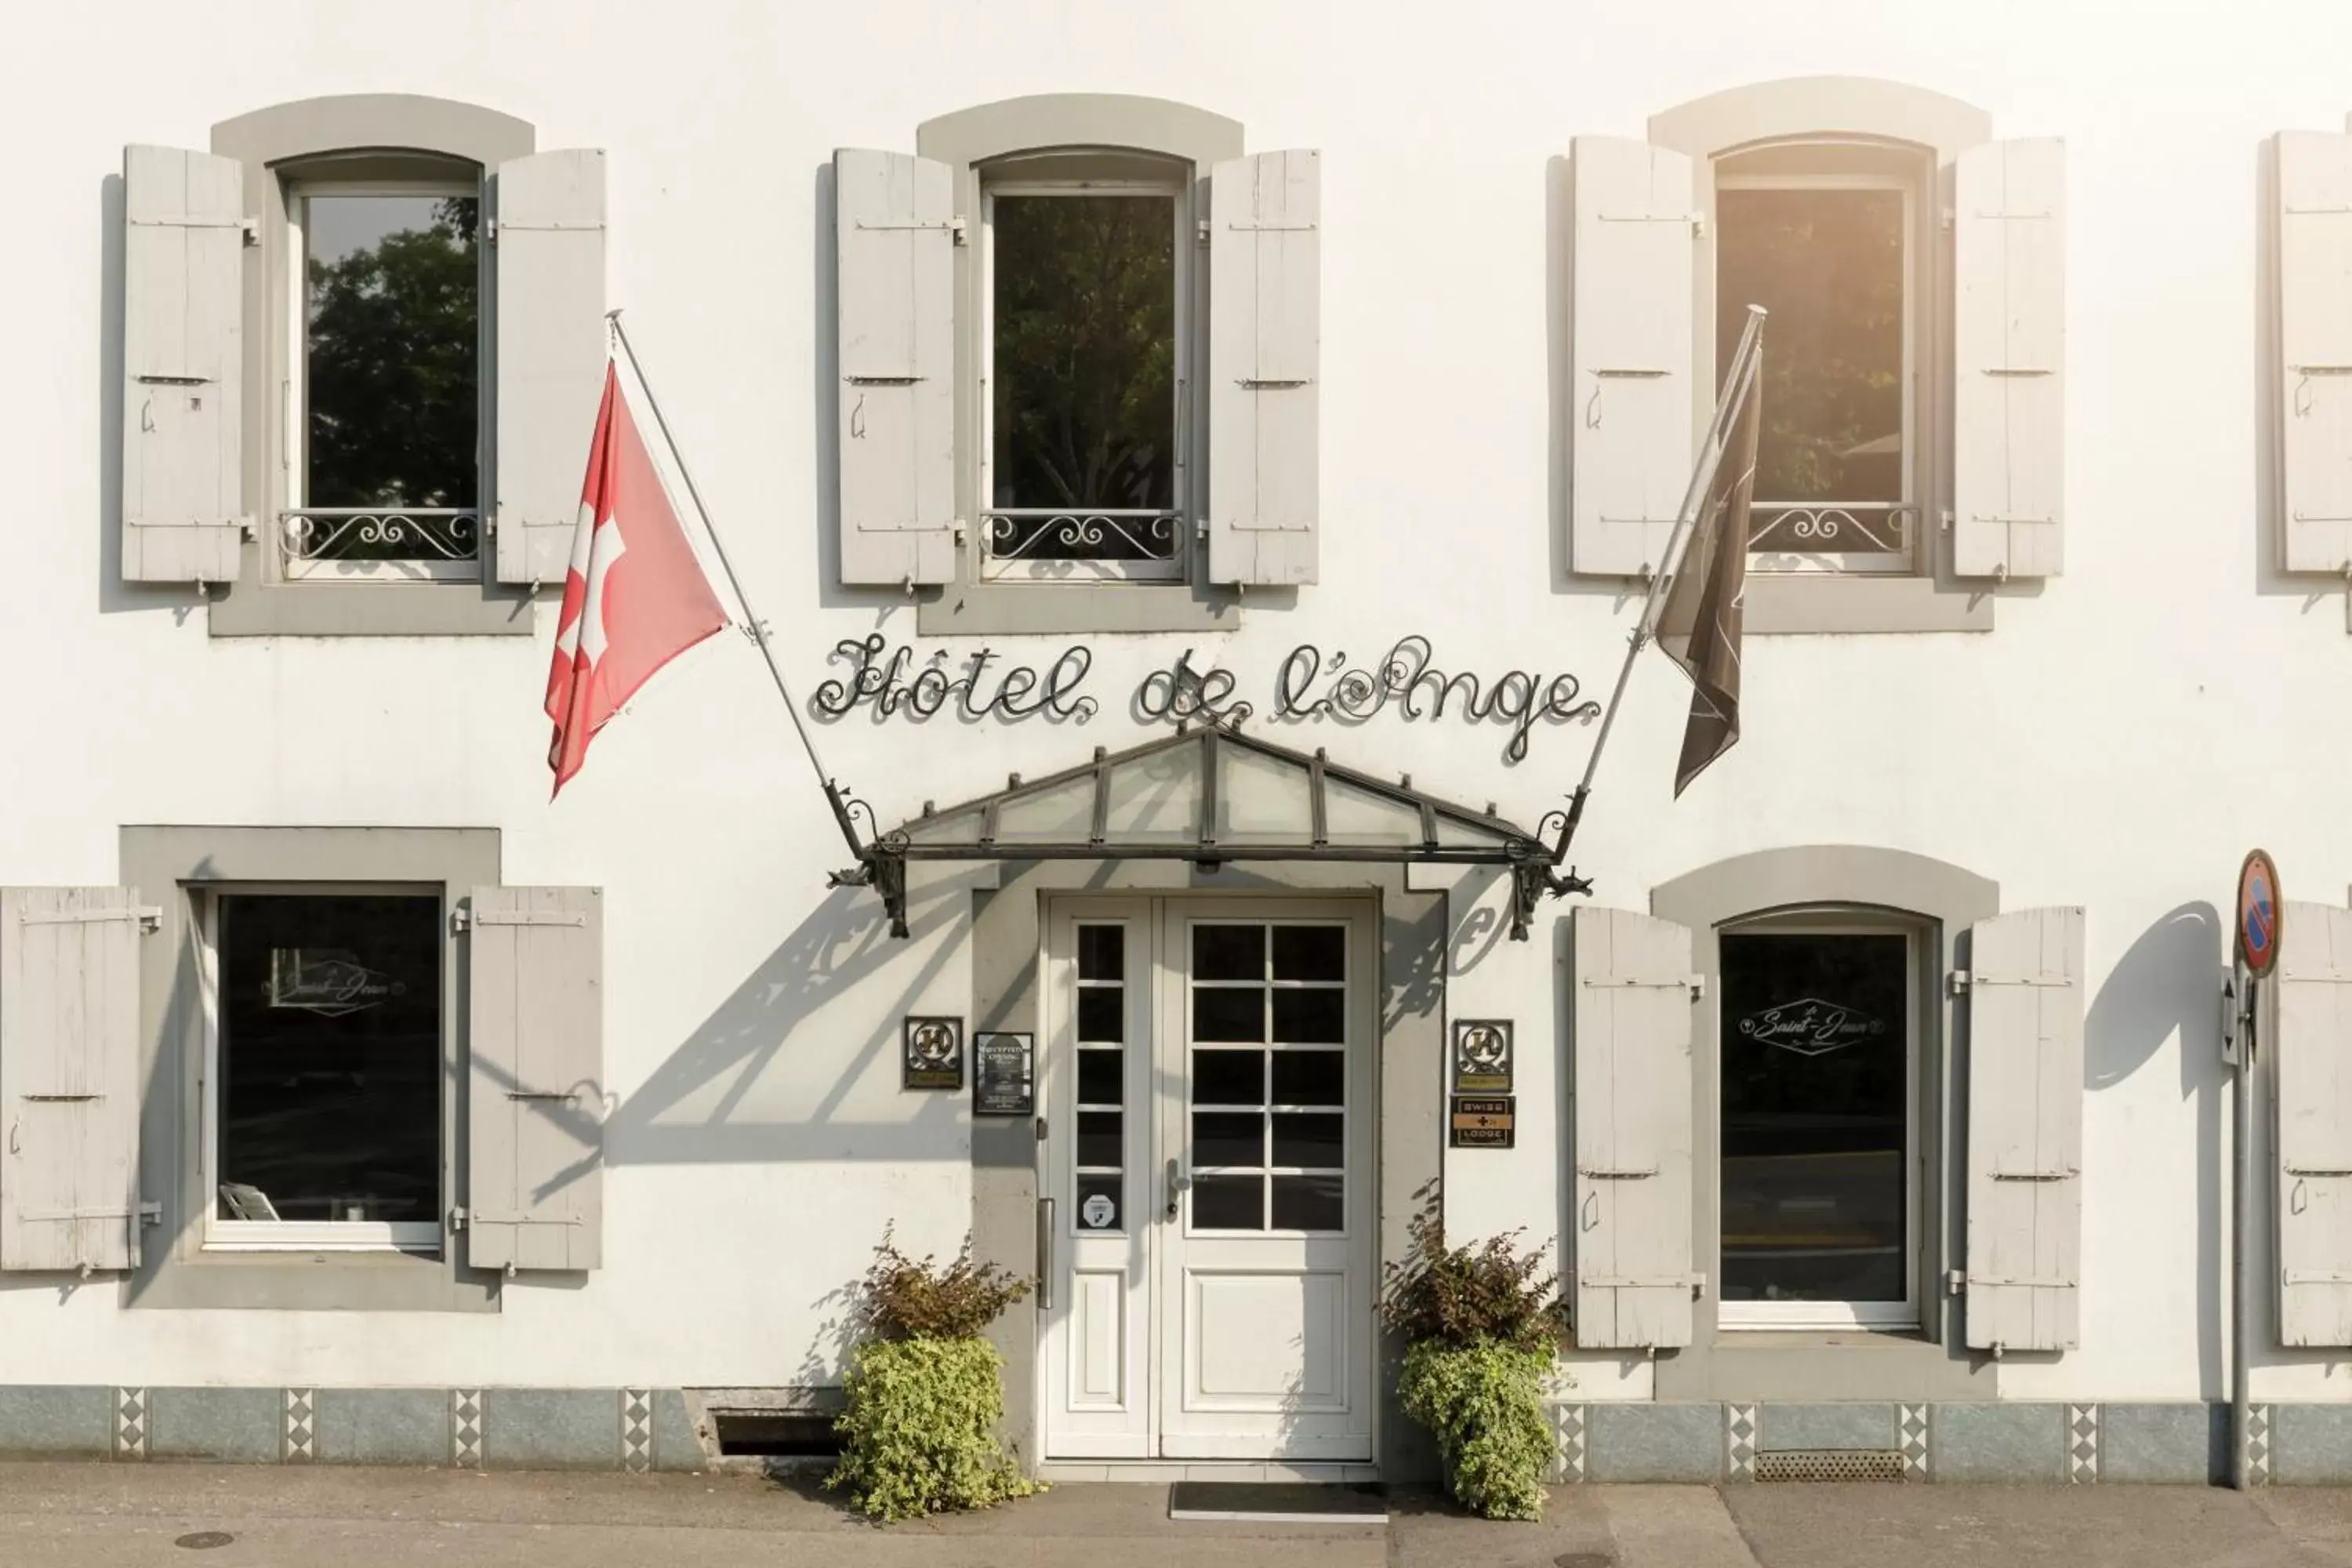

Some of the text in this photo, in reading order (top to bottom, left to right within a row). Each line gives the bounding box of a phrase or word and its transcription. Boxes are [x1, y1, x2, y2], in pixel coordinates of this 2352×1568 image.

[816, 628, 1601, 761] Hôtel de l'Ange
